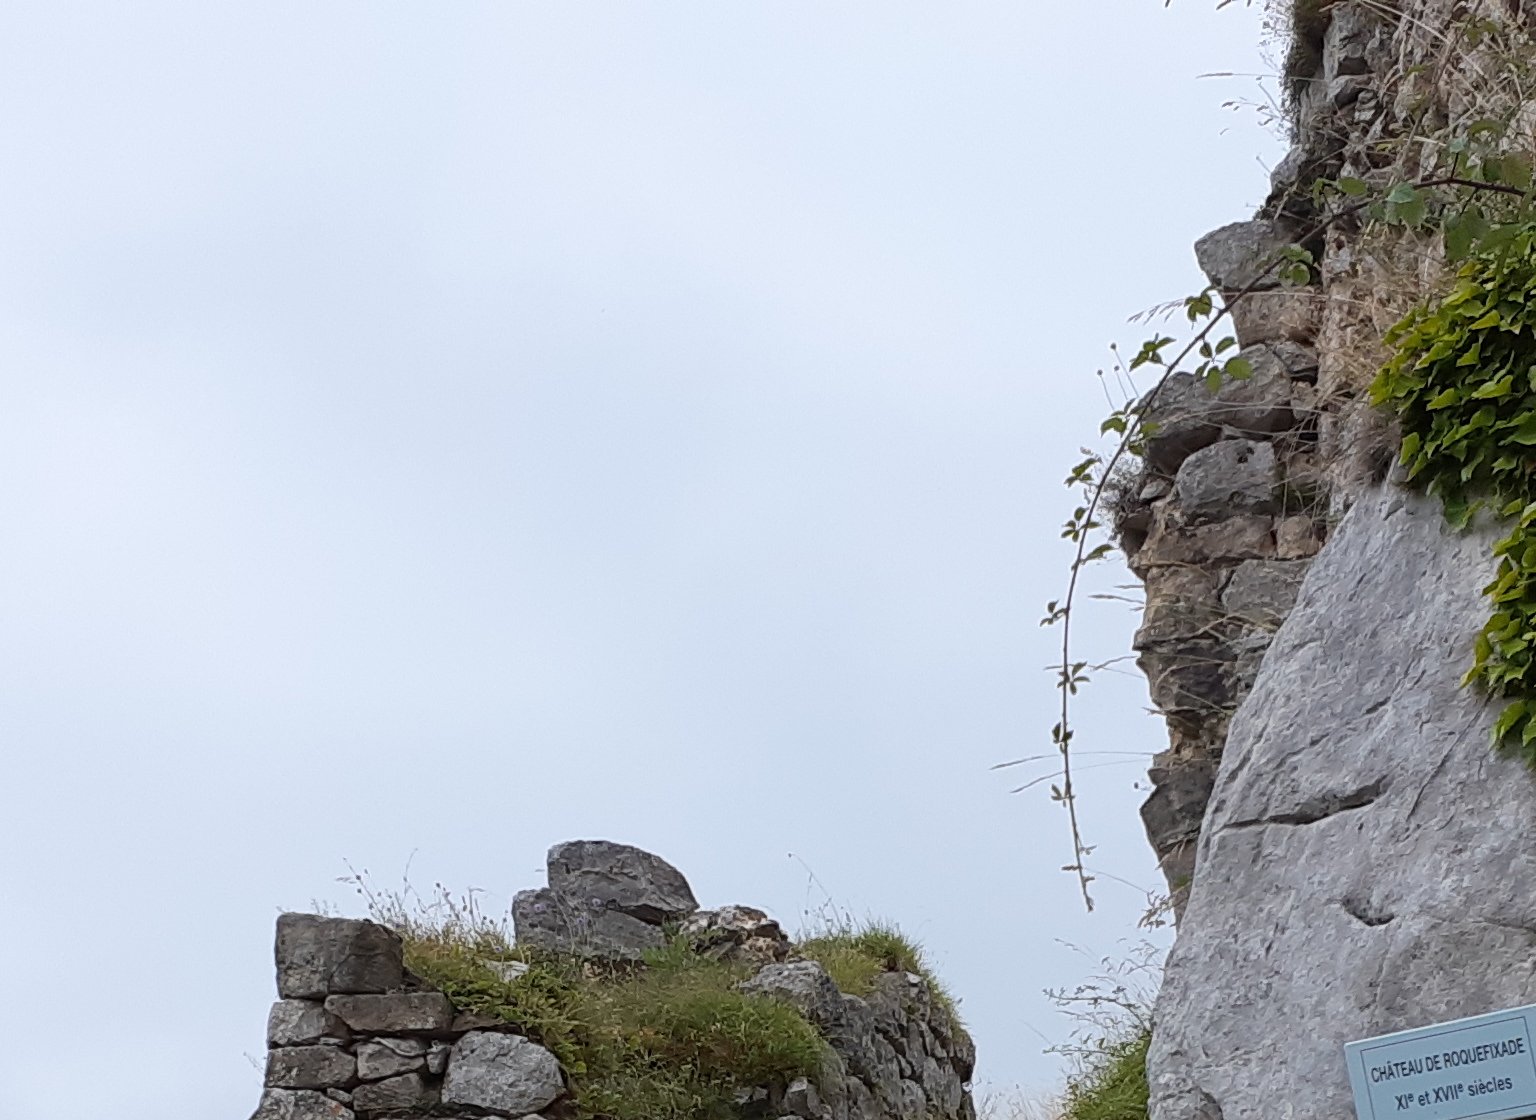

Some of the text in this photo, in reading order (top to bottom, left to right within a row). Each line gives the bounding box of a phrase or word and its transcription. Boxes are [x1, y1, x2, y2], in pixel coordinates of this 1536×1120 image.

[1371, 1037, 1526, 1083] CHÂTEAU DE ROQUEFIXADE
[1417, 1090, 1431, 1106] et
[1468, 1077, 1513, 1097] siècles
